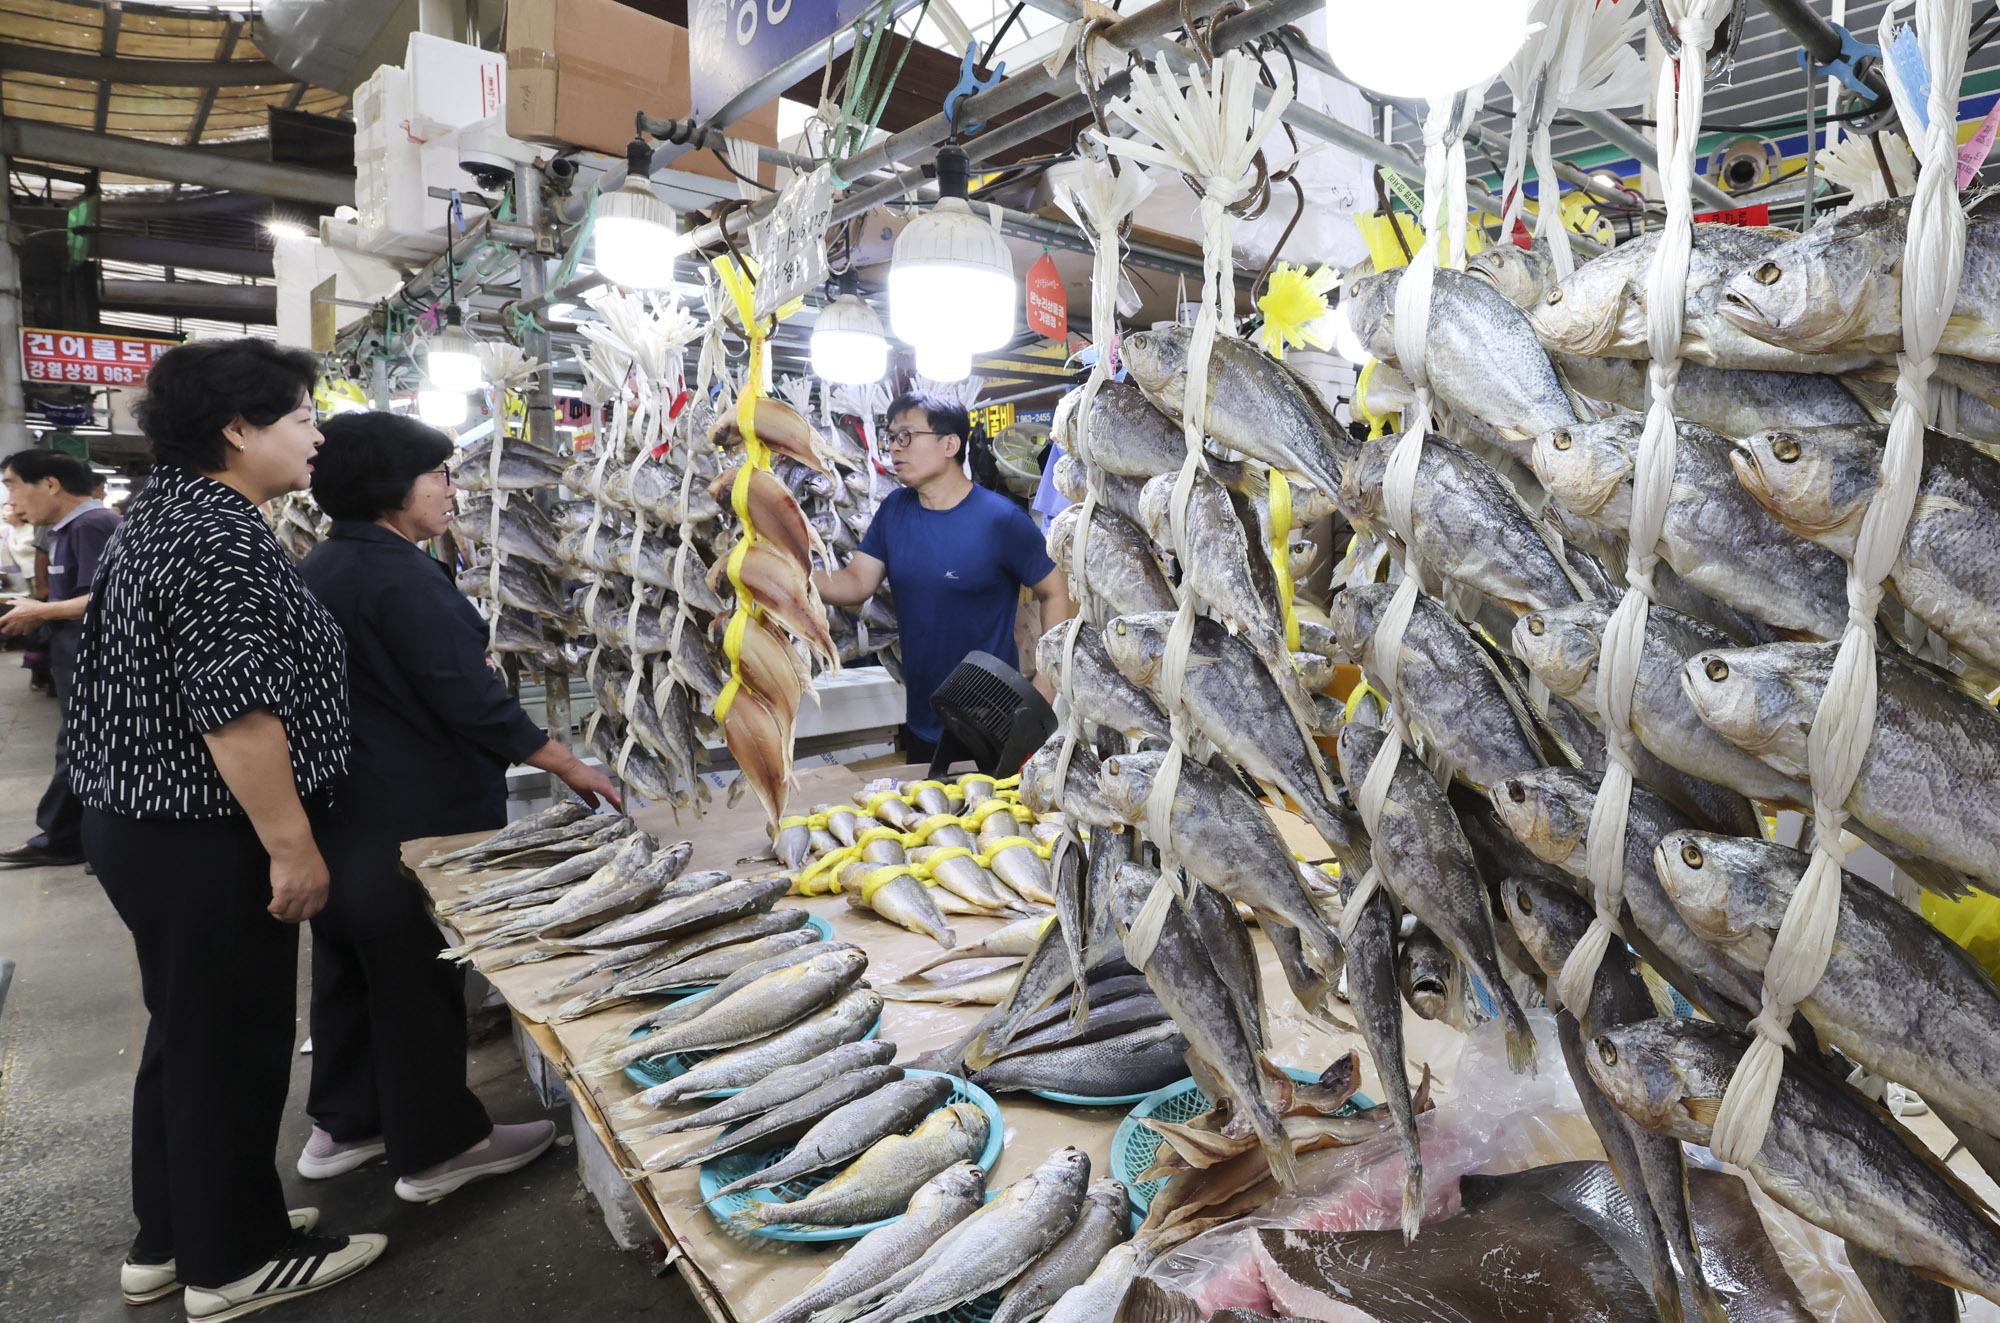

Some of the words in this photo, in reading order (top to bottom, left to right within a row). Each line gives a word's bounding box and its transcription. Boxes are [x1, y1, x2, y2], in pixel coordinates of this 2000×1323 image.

[1030, 291, 1065, 318] 온누리상품권
[1039, 310, 1057, 329] 가맹점
[28, 360, 98, 381] 강원상회
